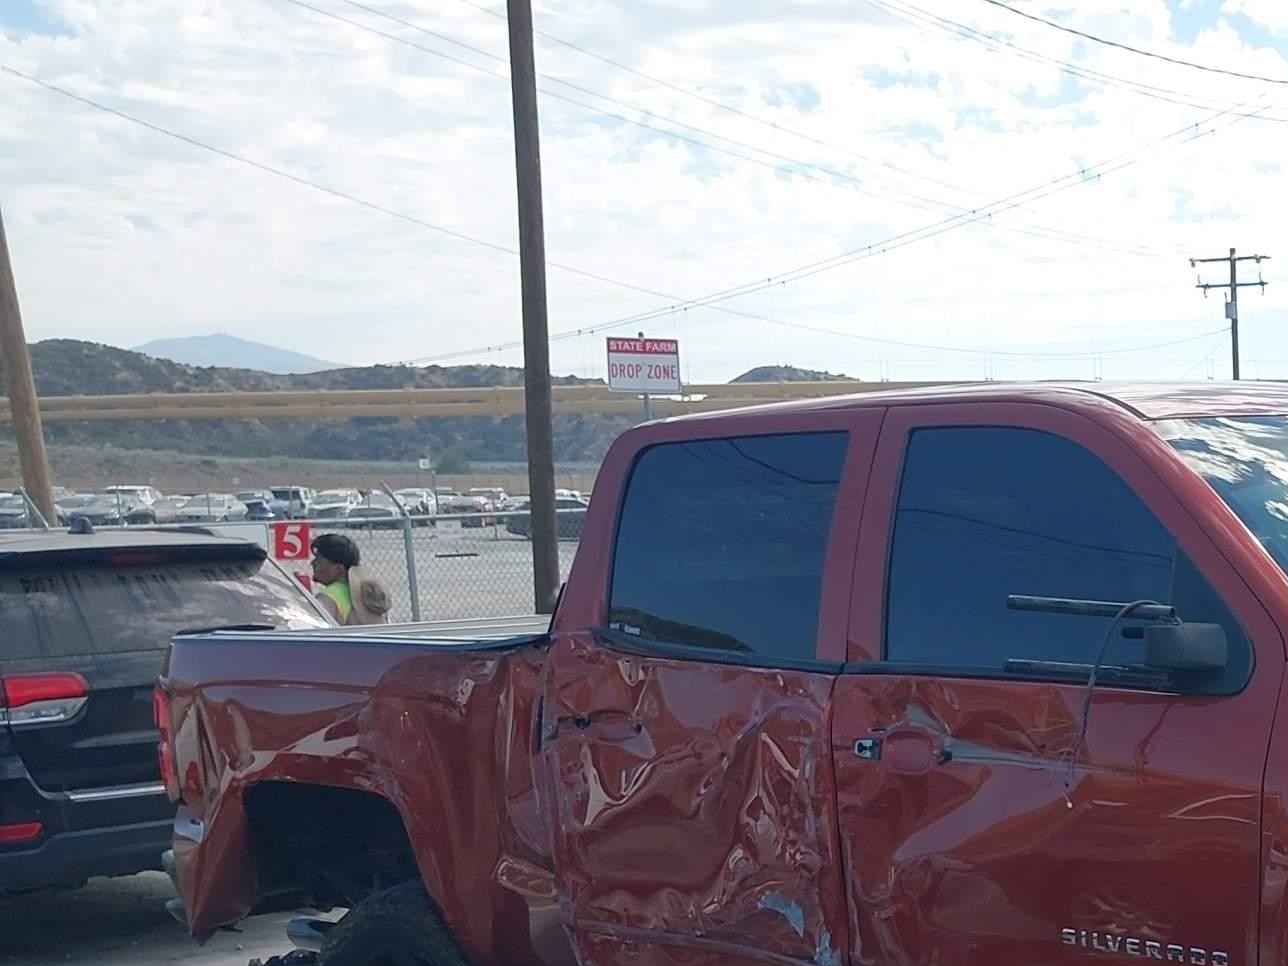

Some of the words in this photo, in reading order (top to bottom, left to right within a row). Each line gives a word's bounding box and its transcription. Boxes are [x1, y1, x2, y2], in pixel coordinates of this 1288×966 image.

[609, 341, 642, 352] STATE
[645, 342, 677, 353] FARM
[611, 363, 642, 378] DROP
[647, 364, 677, 380] ZONE
[282, 525, 302, 556] 5
